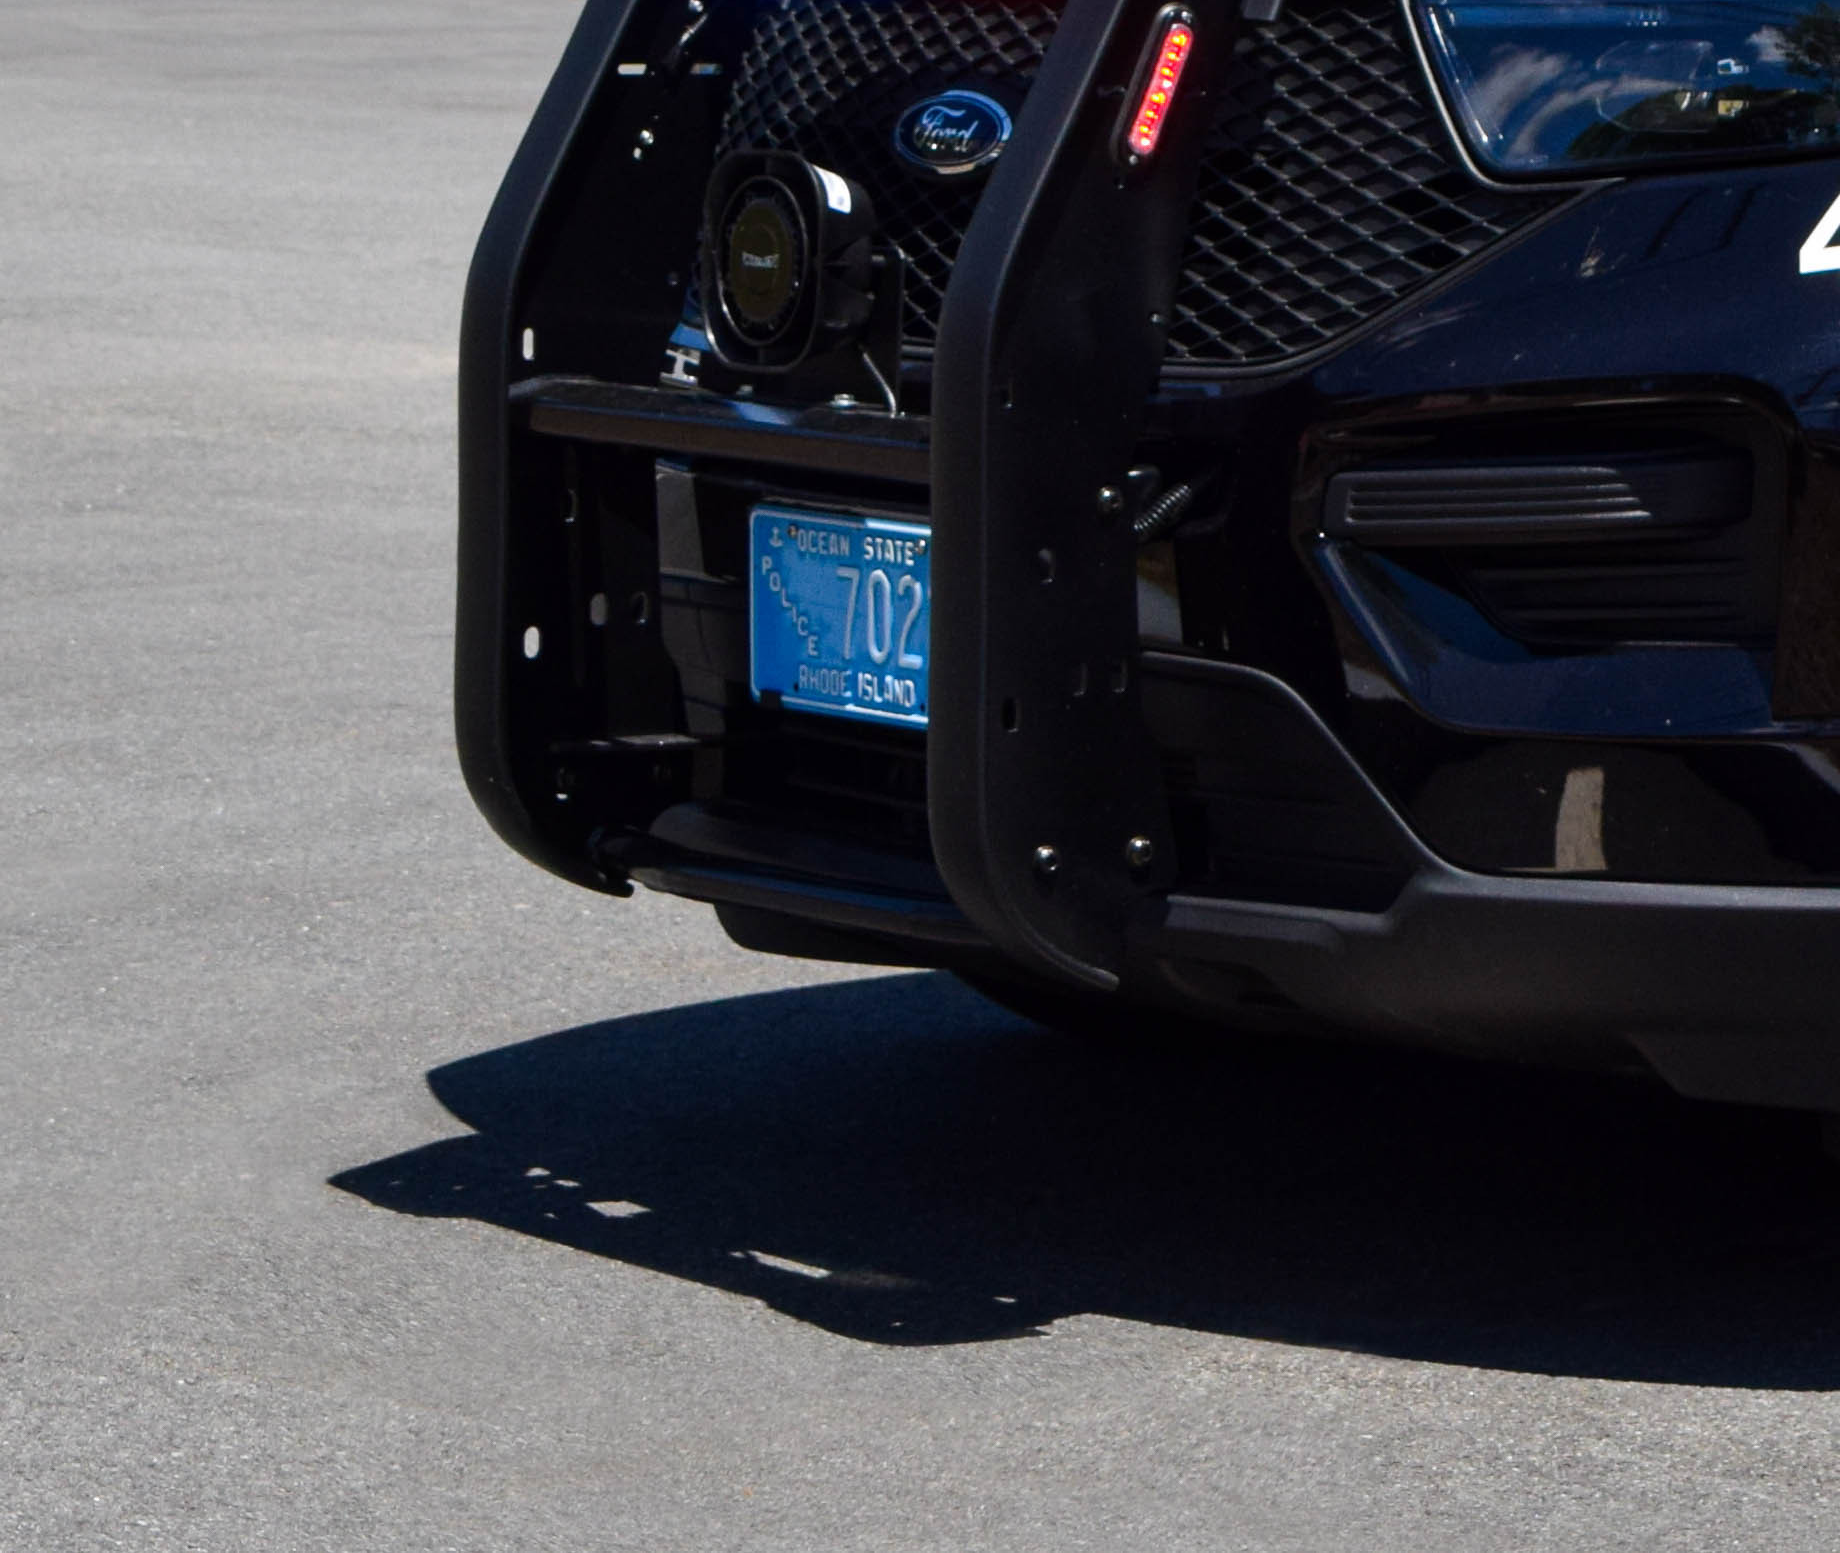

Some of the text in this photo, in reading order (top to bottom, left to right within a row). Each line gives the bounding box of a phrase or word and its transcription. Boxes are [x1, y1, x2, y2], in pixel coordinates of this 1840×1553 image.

[914, 105, 979, 152] Ford
[799, 528, 915, 567] OCEAN STATE
[761, 555, 819, 657] POLICE
[836, 566, 931, 671] 702
[799, 664, 916, 708] RHODE ISLAND
